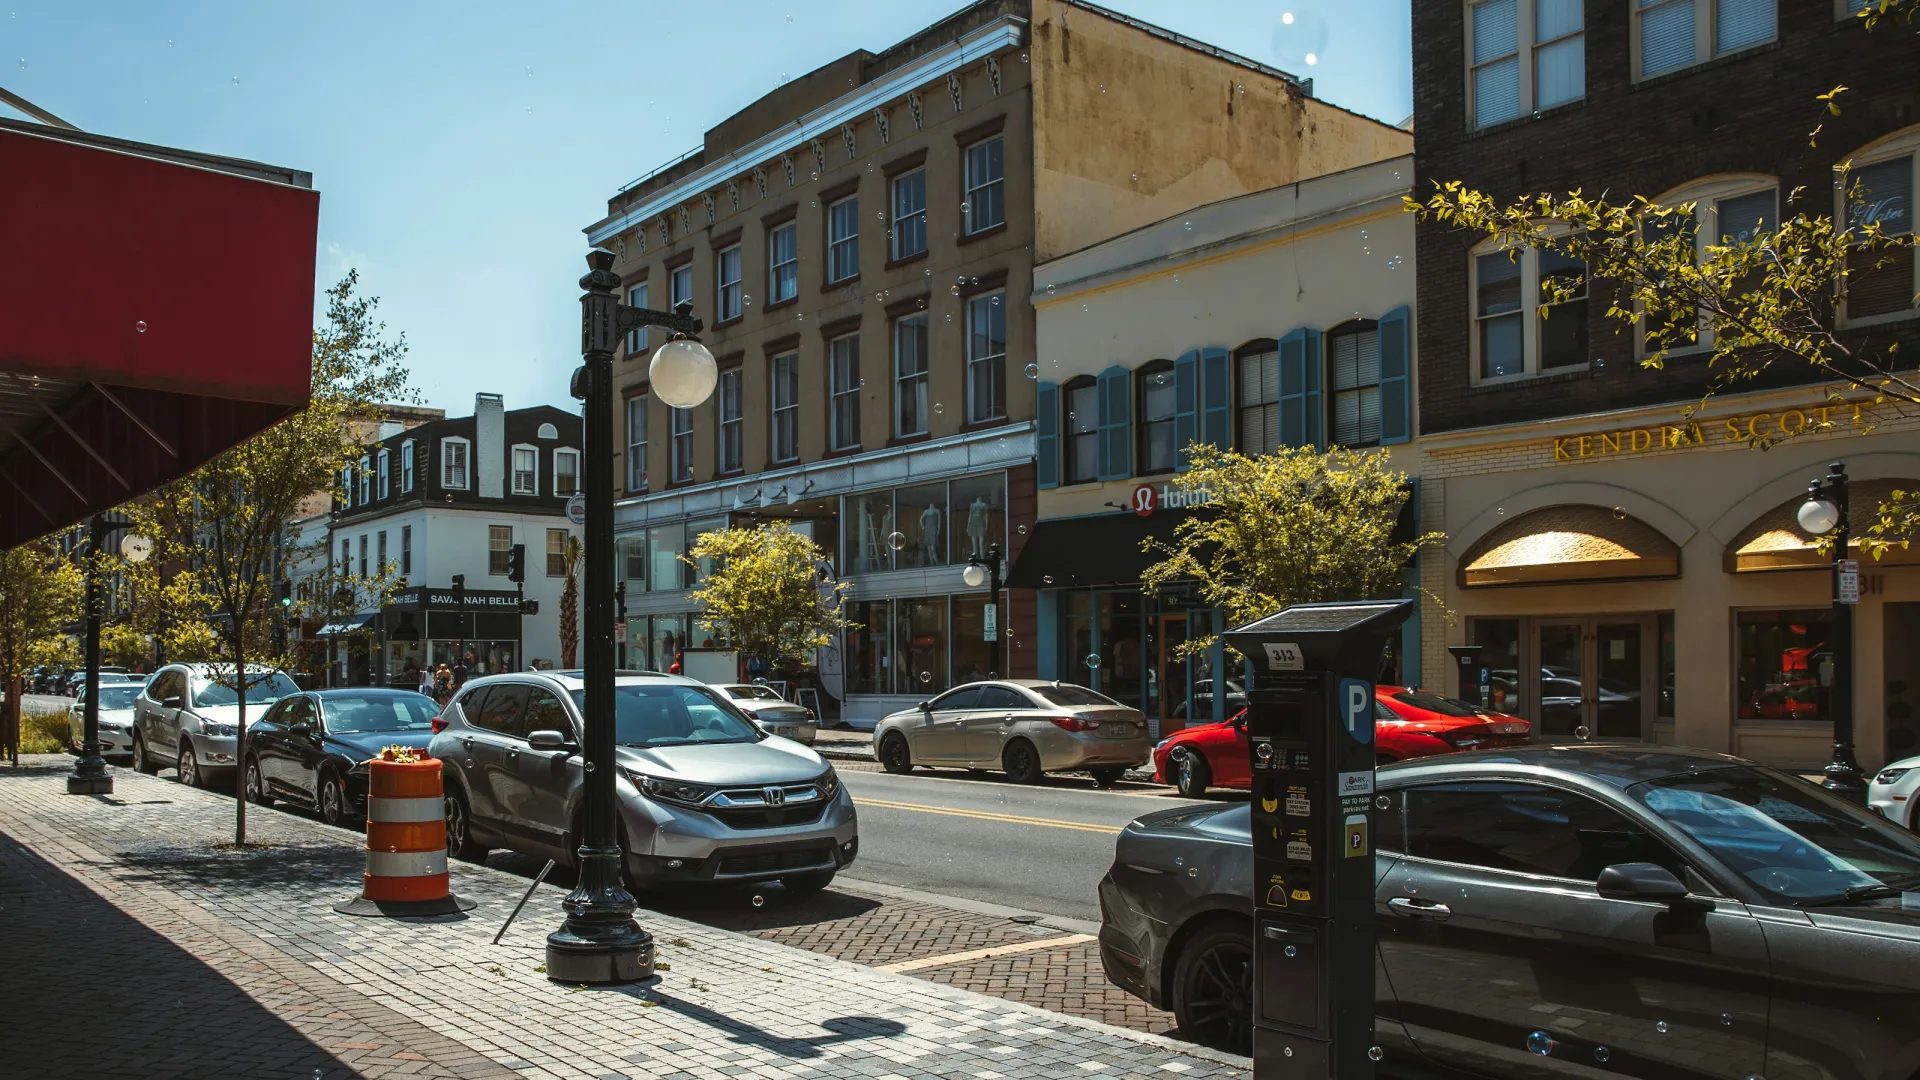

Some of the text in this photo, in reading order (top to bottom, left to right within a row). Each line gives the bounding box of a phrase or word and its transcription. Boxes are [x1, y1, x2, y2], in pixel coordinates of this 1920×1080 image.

[1554, 401, 1874, 460] KENDRA SCOTT
[430, 595, 519, 605] SAVANAH BELLE
[1272, 649, 1295, 661] 313
[1348, 684, 1367, 731] P
[1358, 796, 1370, 804] PARK
